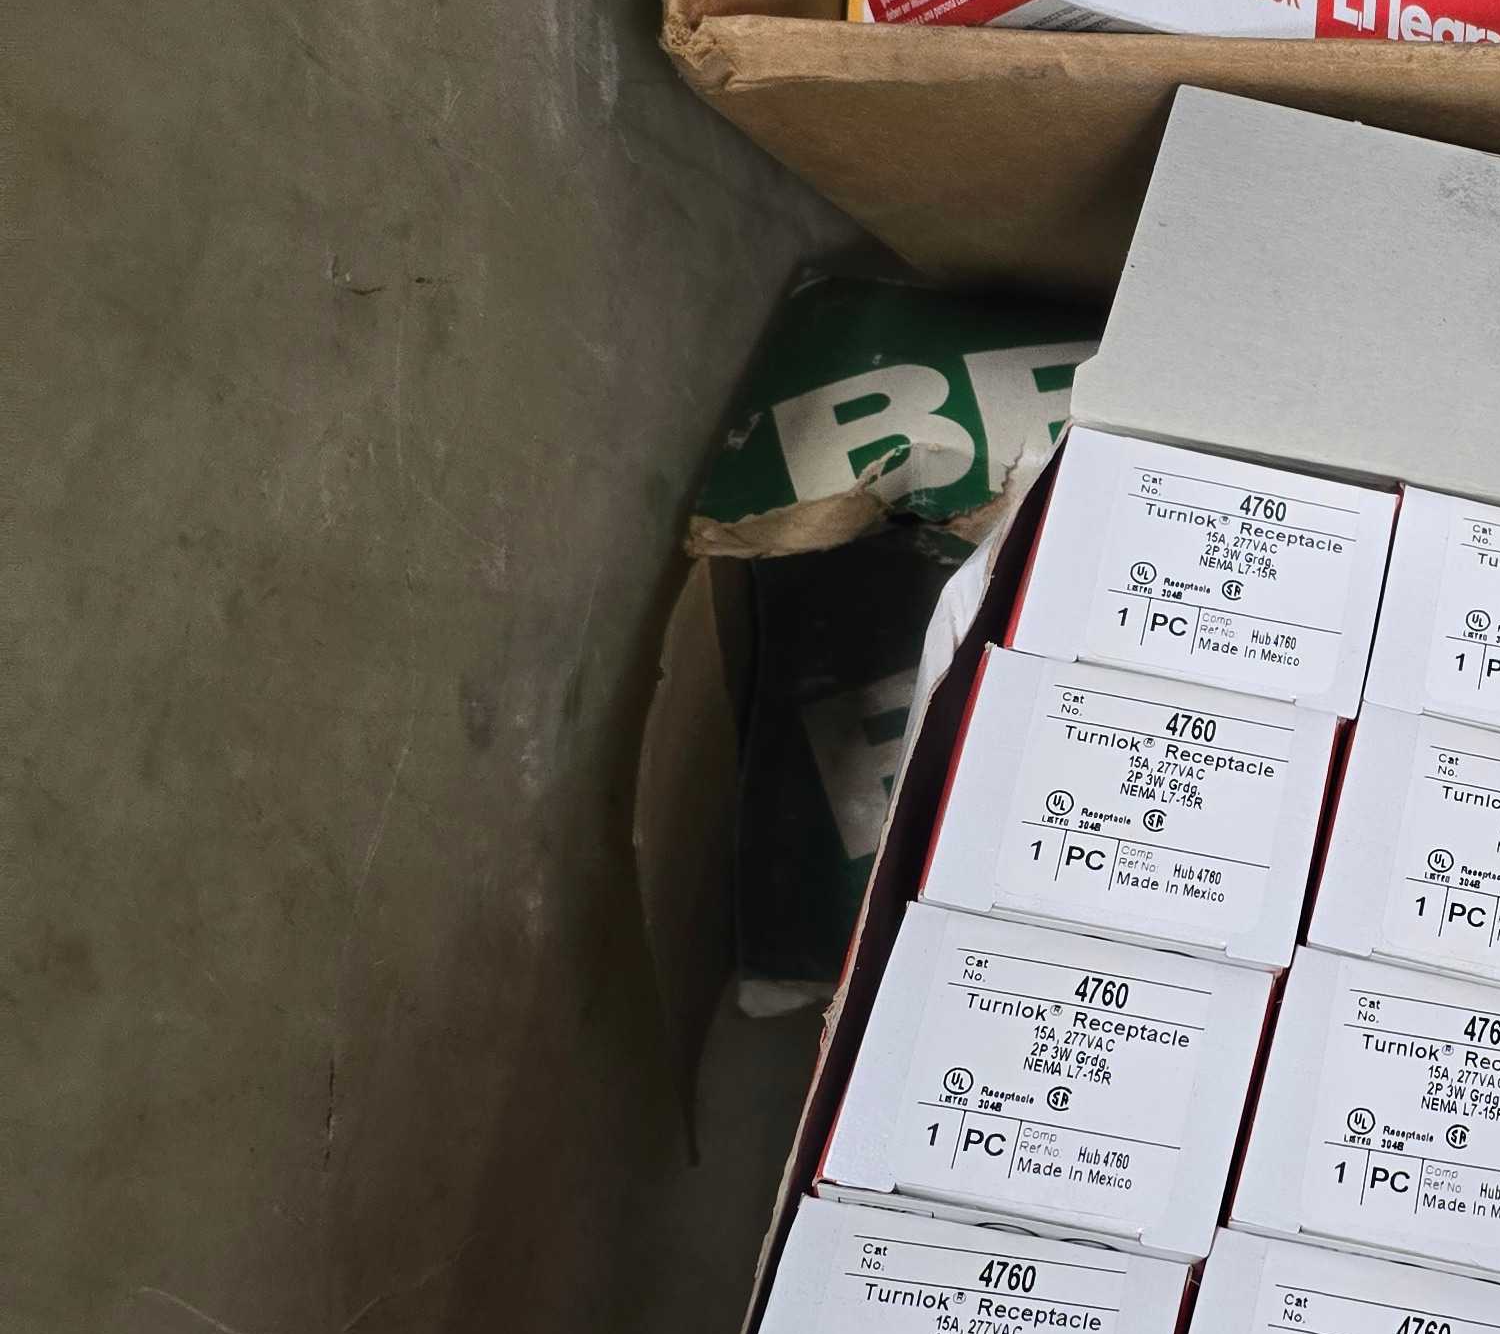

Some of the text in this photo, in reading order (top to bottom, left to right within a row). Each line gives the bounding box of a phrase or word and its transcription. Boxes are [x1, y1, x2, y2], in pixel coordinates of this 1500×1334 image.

[1239, 494, 1287, 522] 4760
[1237, 521, 1343, 553] Receptacle
[1165, 712, 1216, 743] 4760
[1161, 743, 1274, 777] Receptacle
[1074, 975, 1129, 1009] 4760
[1069, 1011, 1189, 1048] Receptacle
[978, 1259, 1036, 1293] 4760
[973, 1297, 1101, 1331] Receptacle
[1282, 1308, 1306, 1324] No.
[1284, 1293, 1308, 1308] Cat
